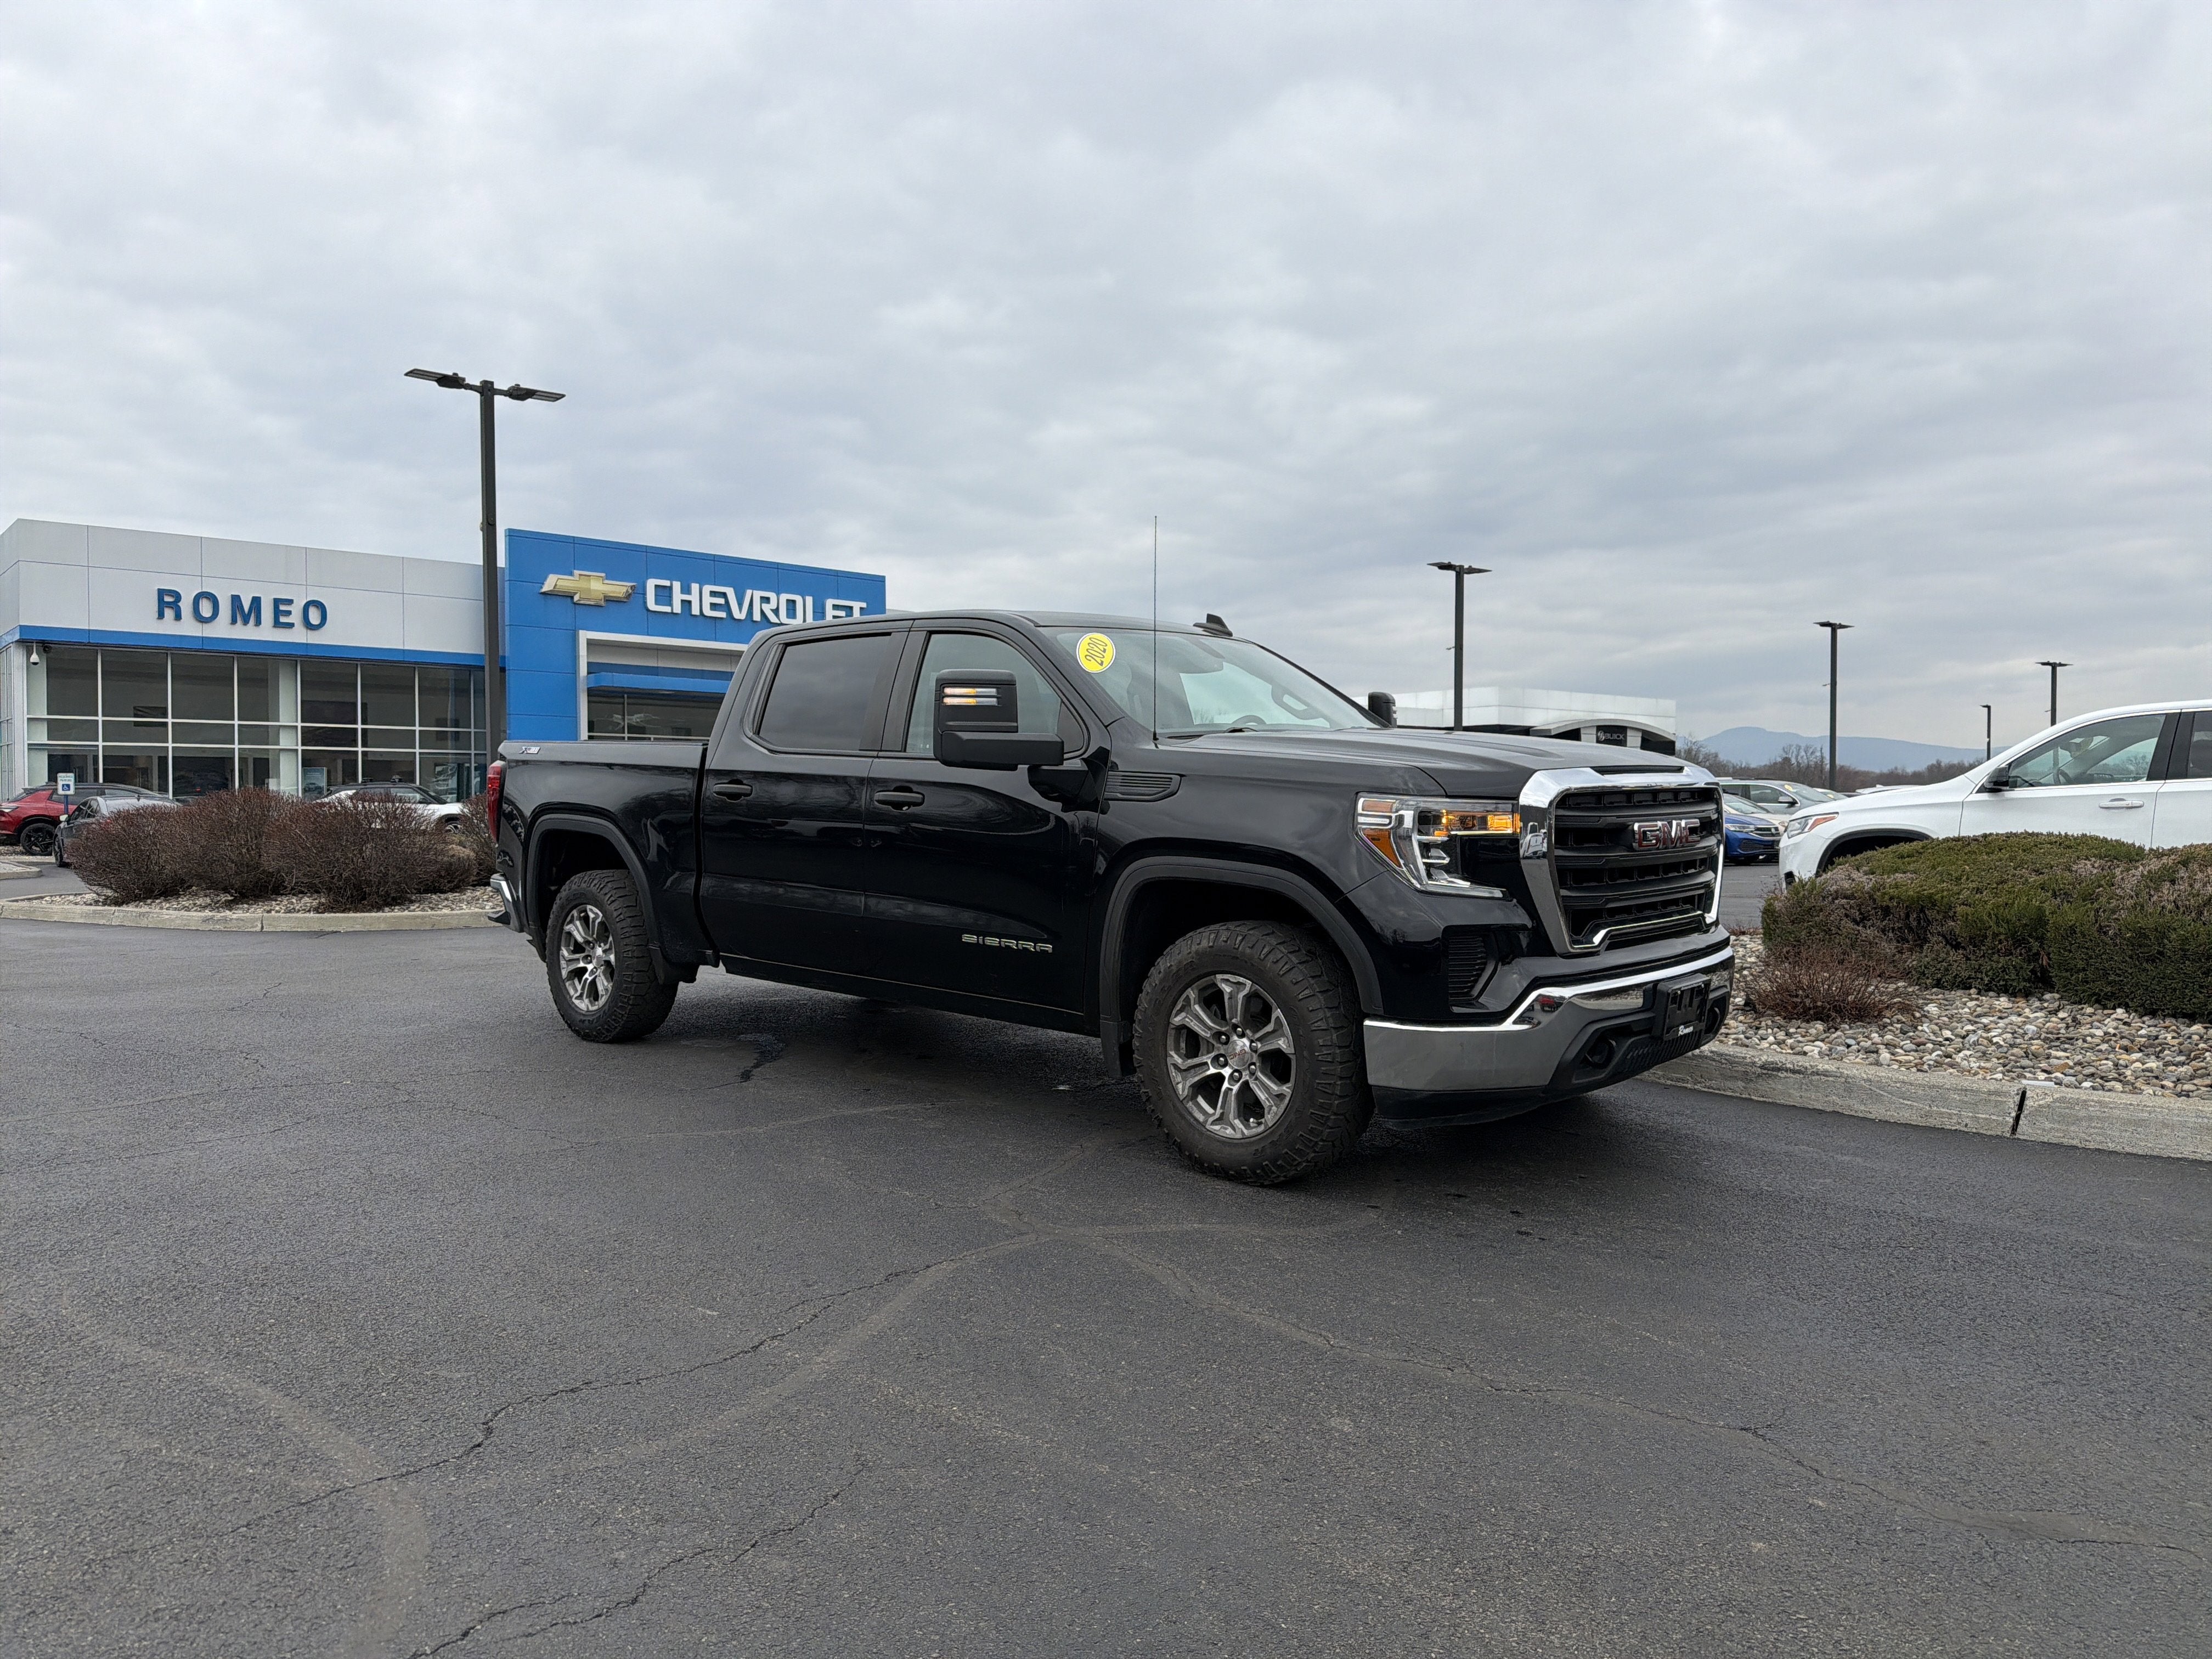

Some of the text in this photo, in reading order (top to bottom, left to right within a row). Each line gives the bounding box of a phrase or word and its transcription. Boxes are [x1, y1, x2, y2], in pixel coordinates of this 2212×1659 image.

[157, 588, 328, 630] ROMEO
[646, 578, 867, 625] CHEVROLET
[1084, 637, 1108, 667] 2020
[1633, 819, 1701, 850] GMC
[962, 934, 1053, 953] SIERRA
[1678, 1025, 1694, 1037] Romeo
[1229, 1048, 1246, 1060] GMC
